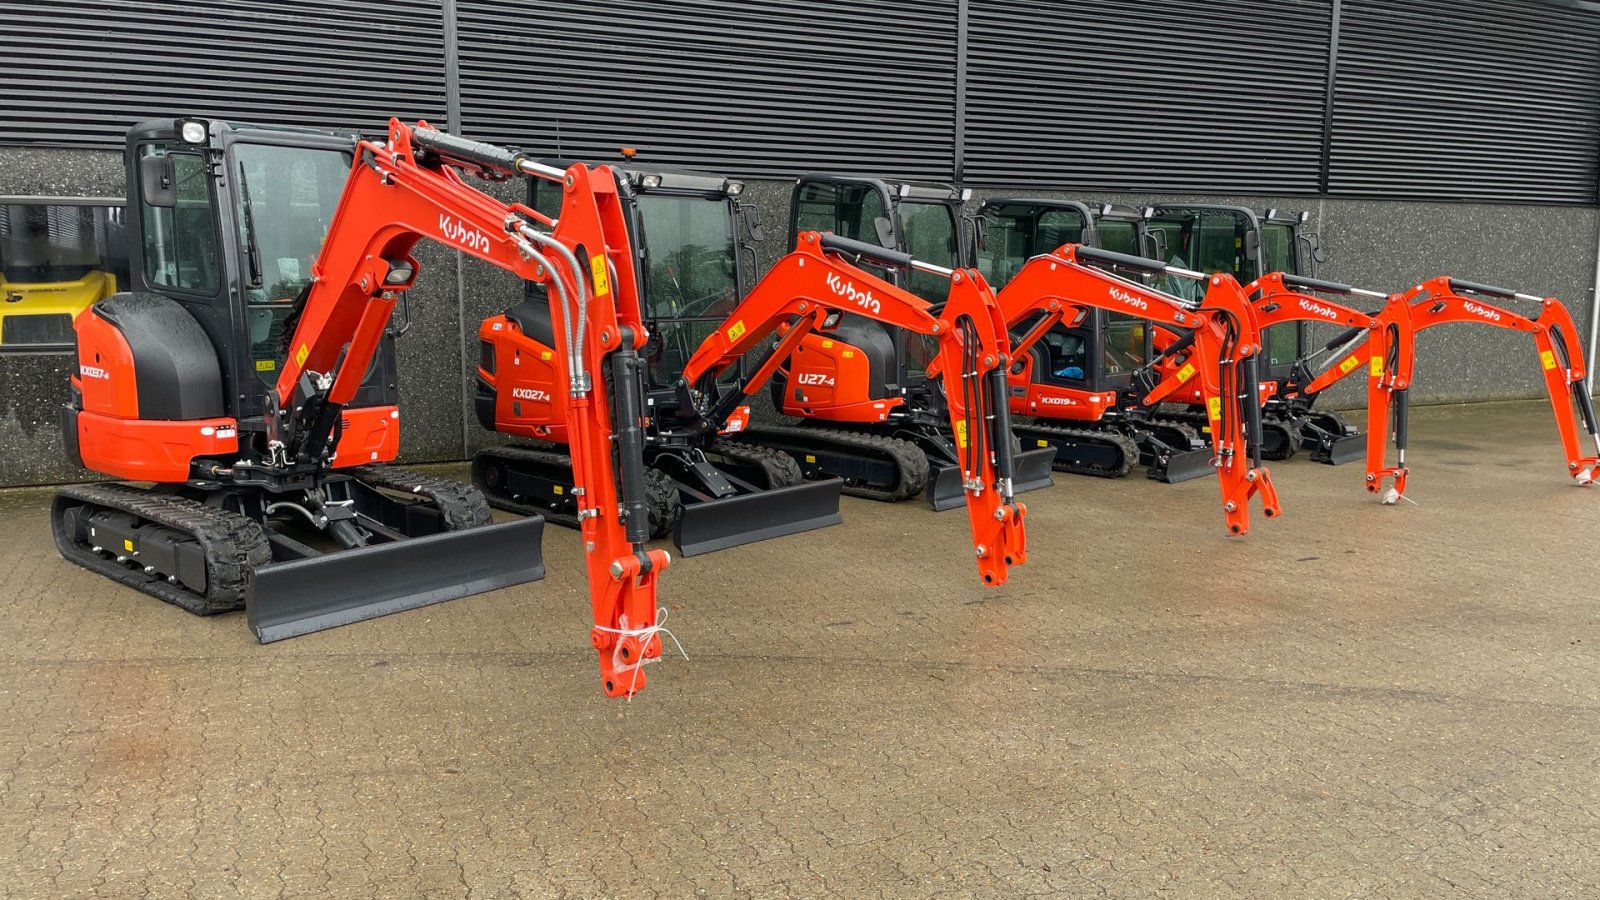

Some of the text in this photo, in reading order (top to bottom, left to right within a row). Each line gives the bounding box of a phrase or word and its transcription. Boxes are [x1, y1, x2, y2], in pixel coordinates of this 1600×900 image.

[439, 213, 490, 254] Kubota
[826, 271, 881, 315] Kubota
[1109, 286, 1148, 311] Kubota
[1298, 298, 1337, 320] Kubota
[1463, 301, 1501, 321] Kubota
[798, 372, 835, 386] U27-4
[512, 387, 551, 402] KX027-4
